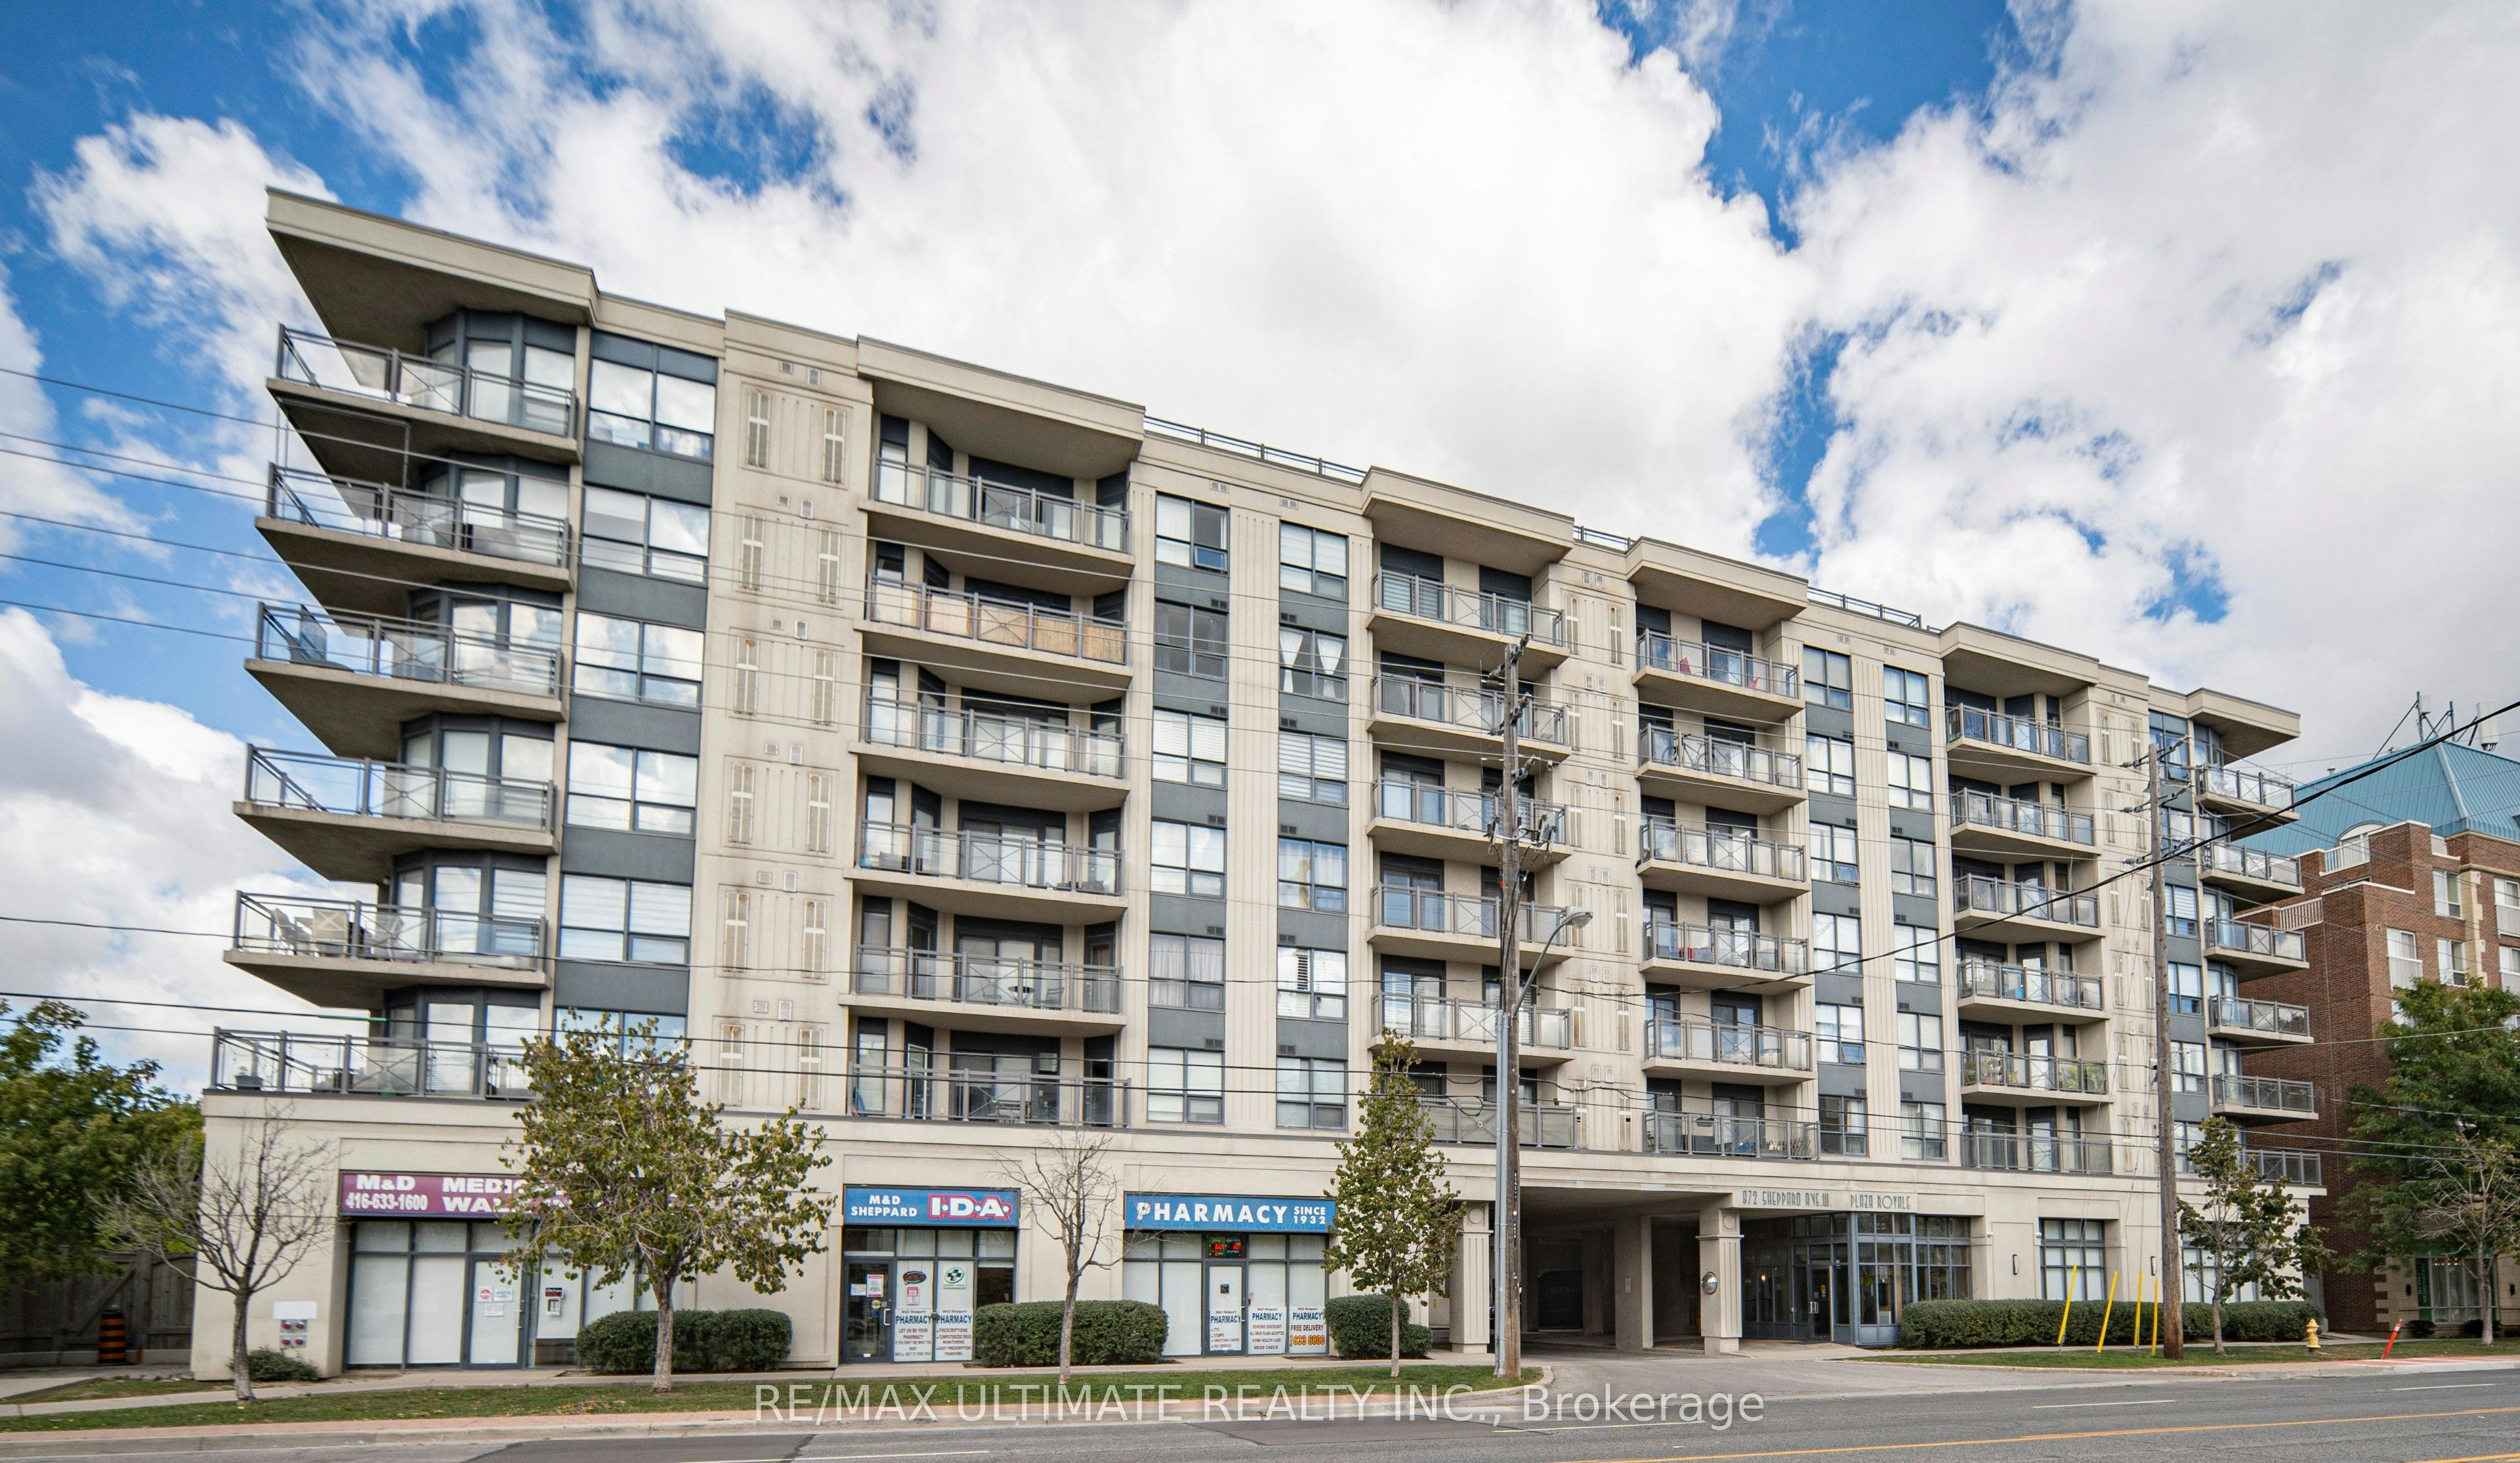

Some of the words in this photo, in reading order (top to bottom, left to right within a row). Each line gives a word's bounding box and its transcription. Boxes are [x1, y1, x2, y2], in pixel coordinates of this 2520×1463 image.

[356, 1174, 415, 1191] M&D
[346, 1192, 428, 1210] 416-633-1600
[869, 1195, 901, 1205] M&D
[1742, 1190, 1757, 1205] 872
[1763, 1191, 1801, 1206] SHEPPARD
[1851, 1194, 1873, 1208] PLAZA
[1878, 1195, 1911, 1210] ROYALE
[850, 1206, 917, 1217] SHEPPARD
[1137, 1202, 1288, 1224] PHARMACY
[1293, 1206, 1326, 1215] SINCE
[1293, 1215, 1326, 1224] 1932
[895, 1315, 932, 1324] PHARMACY
[936, 1315, 972, 1323] PHARMACY
[1210, 1315, 1240, 1323] PHARMACY
[1252, 1312, 1282, 1321] PHARMACY
[1293, 1335, 1307, 1346] 633
[1308, 1334, 1326, 1346] 6800
